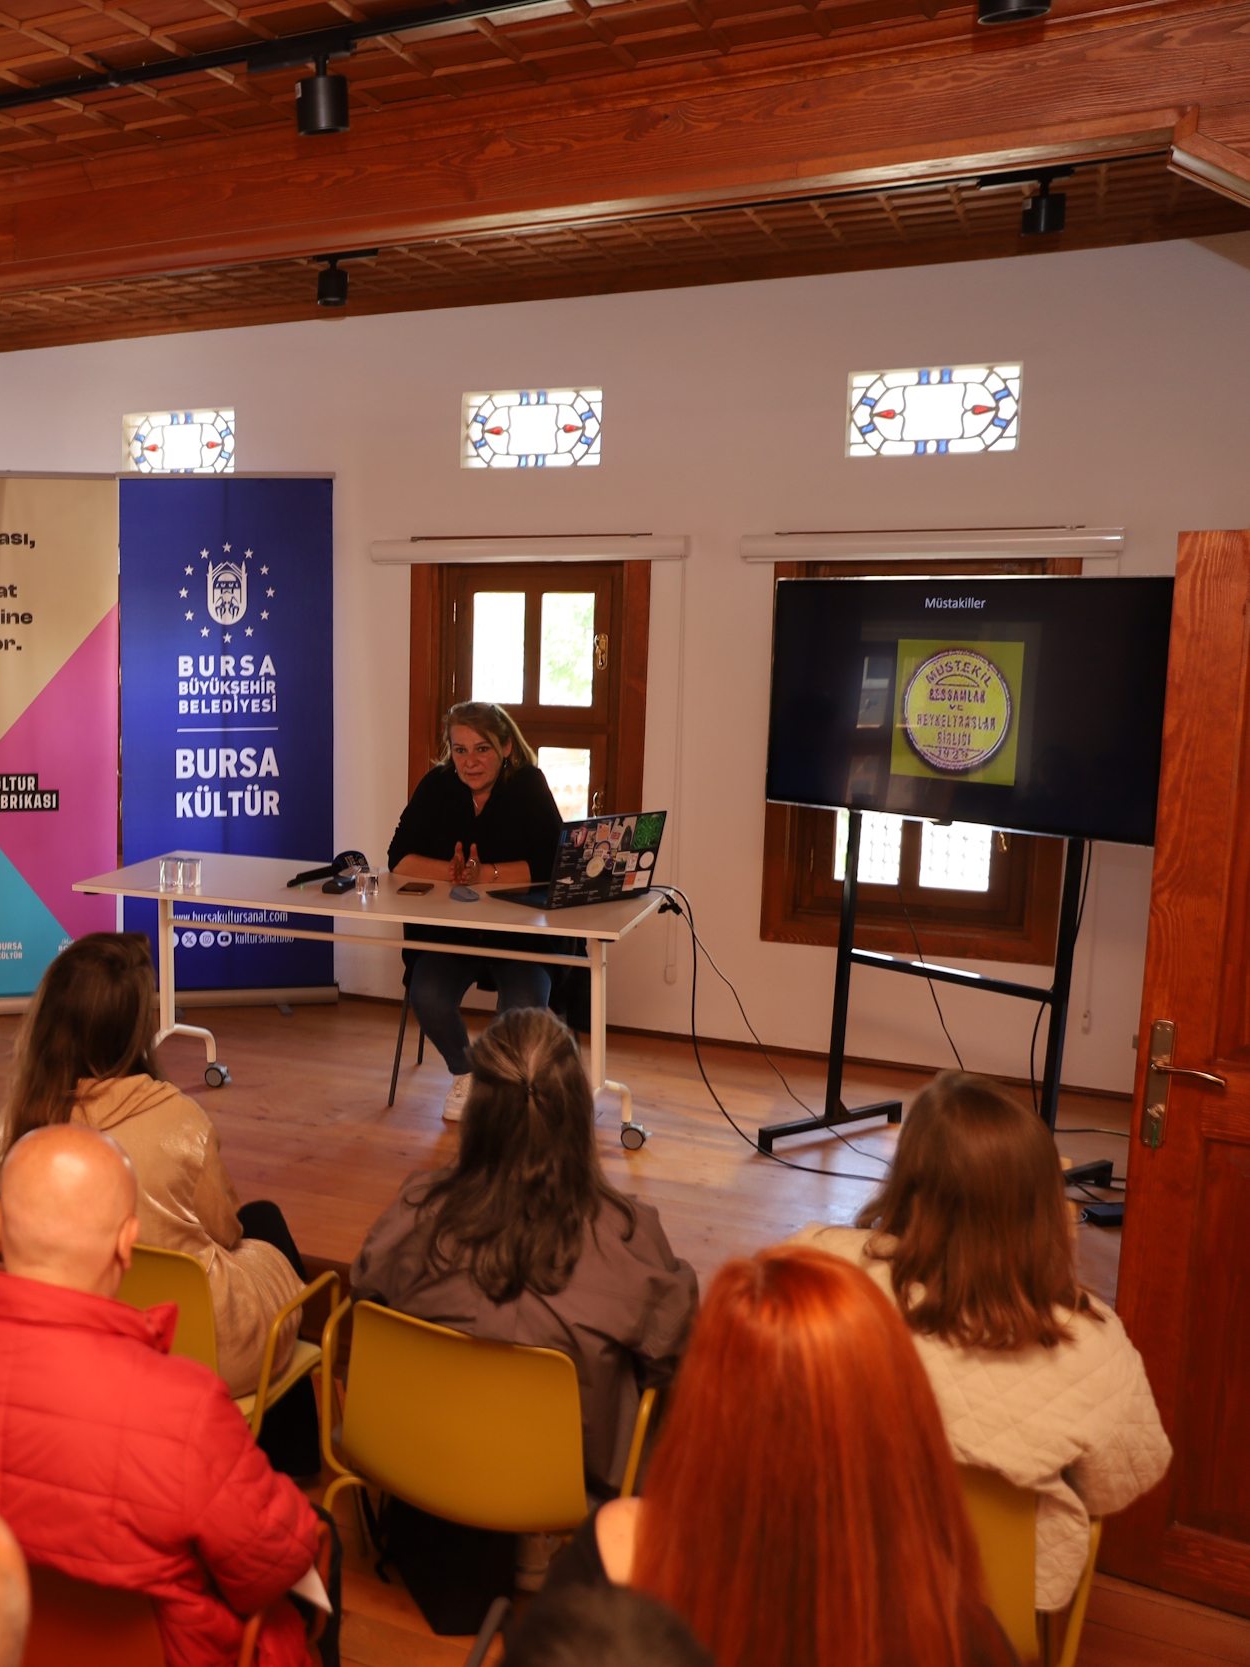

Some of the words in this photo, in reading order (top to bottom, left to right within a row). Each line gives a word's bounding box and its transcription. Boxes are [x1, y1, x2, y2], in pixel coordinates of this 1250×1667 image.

[924, 597, 986, 609] Müstakiller
[178, 654, 276, 677] BURSA
[178, 677, 276, 697] BÜYÜKŞEHİR
[178, 695, 277, 714] BELEDİYESİ
[175, 747, 280, 779] BURSA
[175, 784, 280, 818] KÜLTÜR
[174, 909, 288, 924] wwbursakultursanat.com
